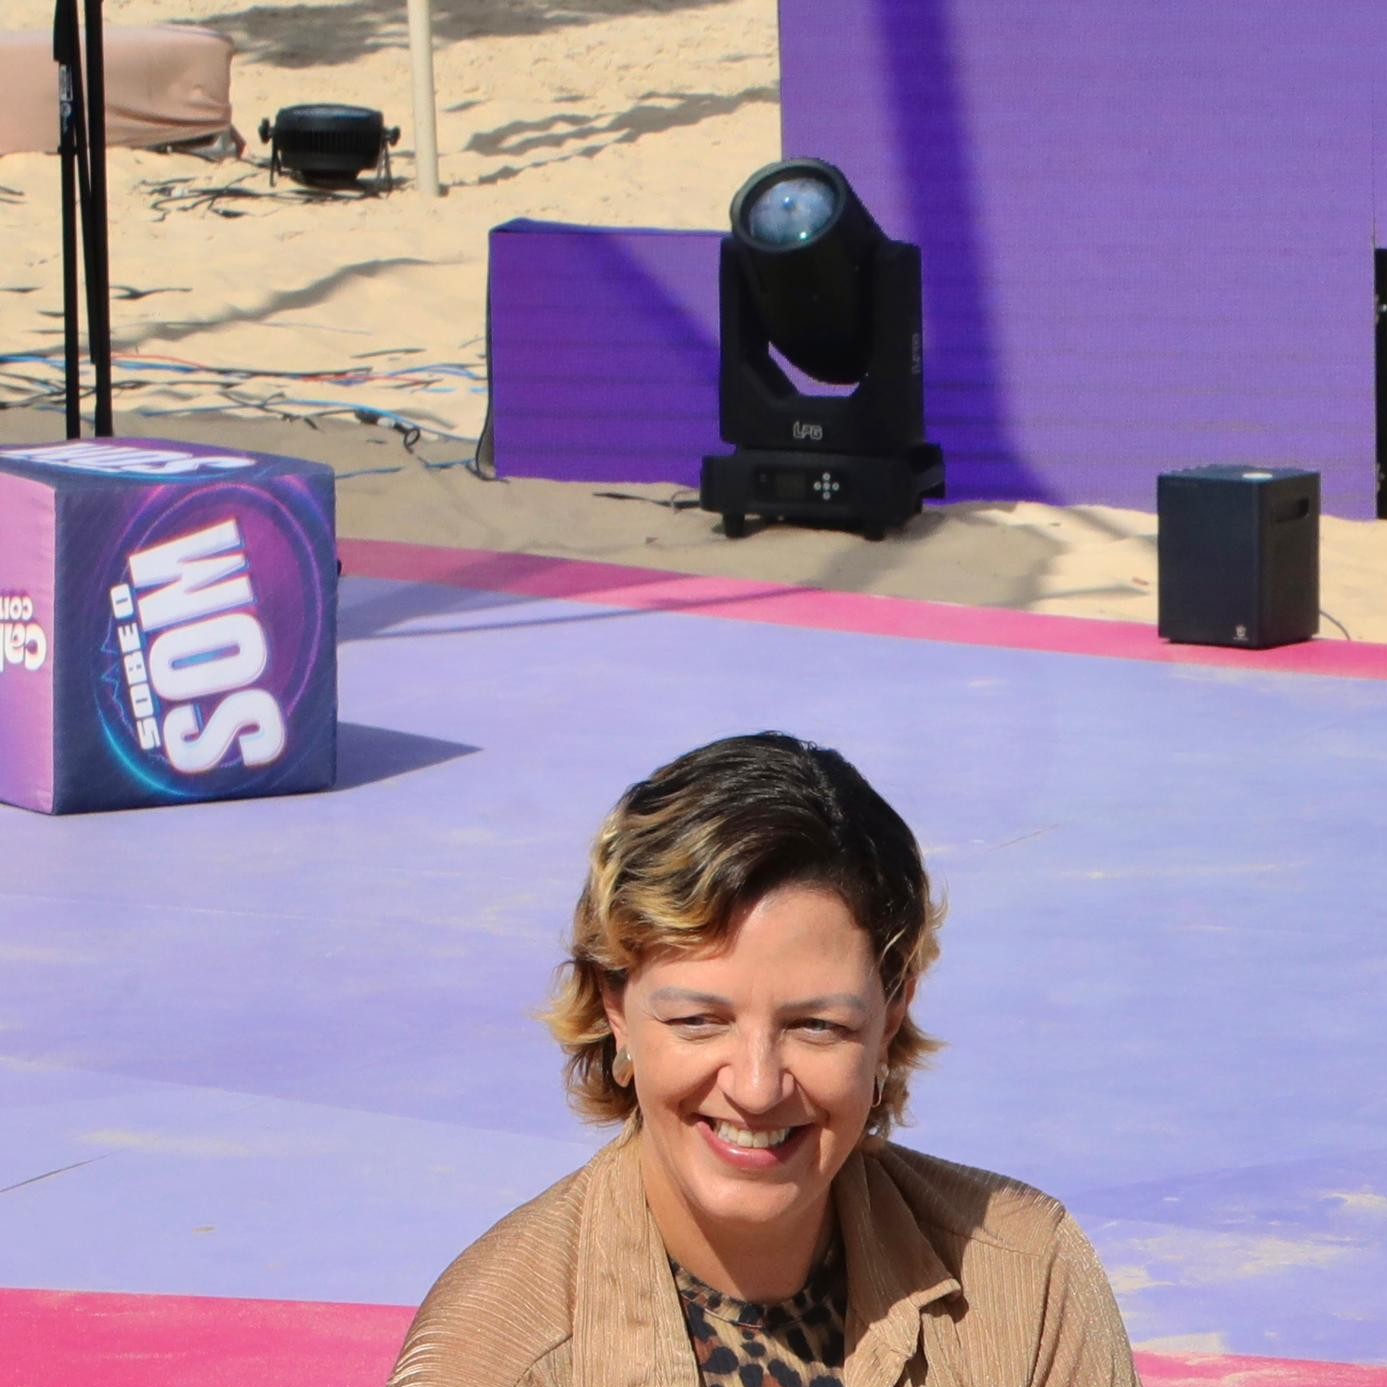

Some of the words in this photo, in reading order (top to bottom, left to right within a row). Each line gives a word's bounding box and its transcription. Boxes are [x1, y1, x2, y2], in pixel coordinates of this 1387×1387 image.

[793, 421, 823, 440] LPG
[110, 584, 135, 619] O
[117, 622, 161, 750] SOBE
[130, 518, 286, 774] SOM
